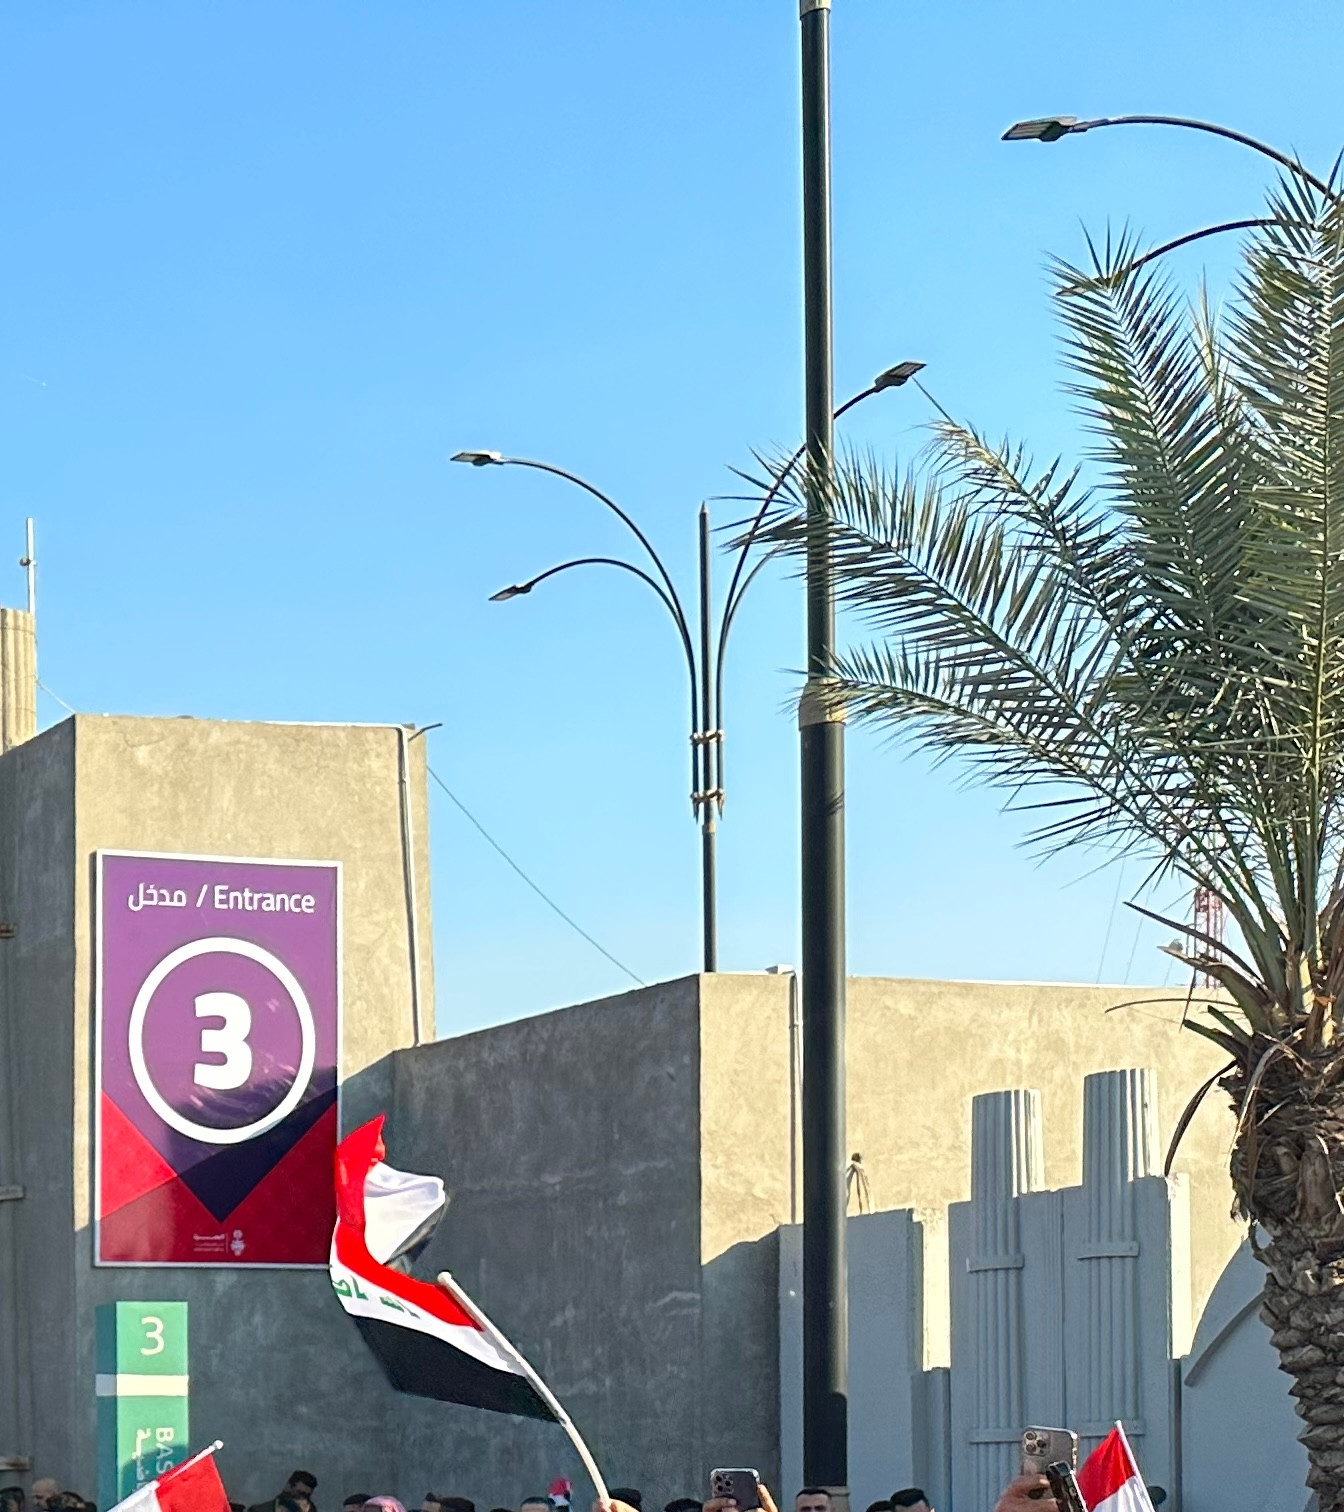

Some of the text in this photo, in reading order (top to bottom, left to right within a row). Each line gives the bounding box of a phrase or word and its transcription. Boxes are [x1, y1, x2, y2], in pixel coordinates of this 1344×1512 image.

[128, 882, 187, 912] مدخل
[214, 885, 316, 914] Entrance
[193, 992, 254, 1090] 3
[140, 1316, 165, 1356] 3
[155, 1427, 174, 1474] BAS
